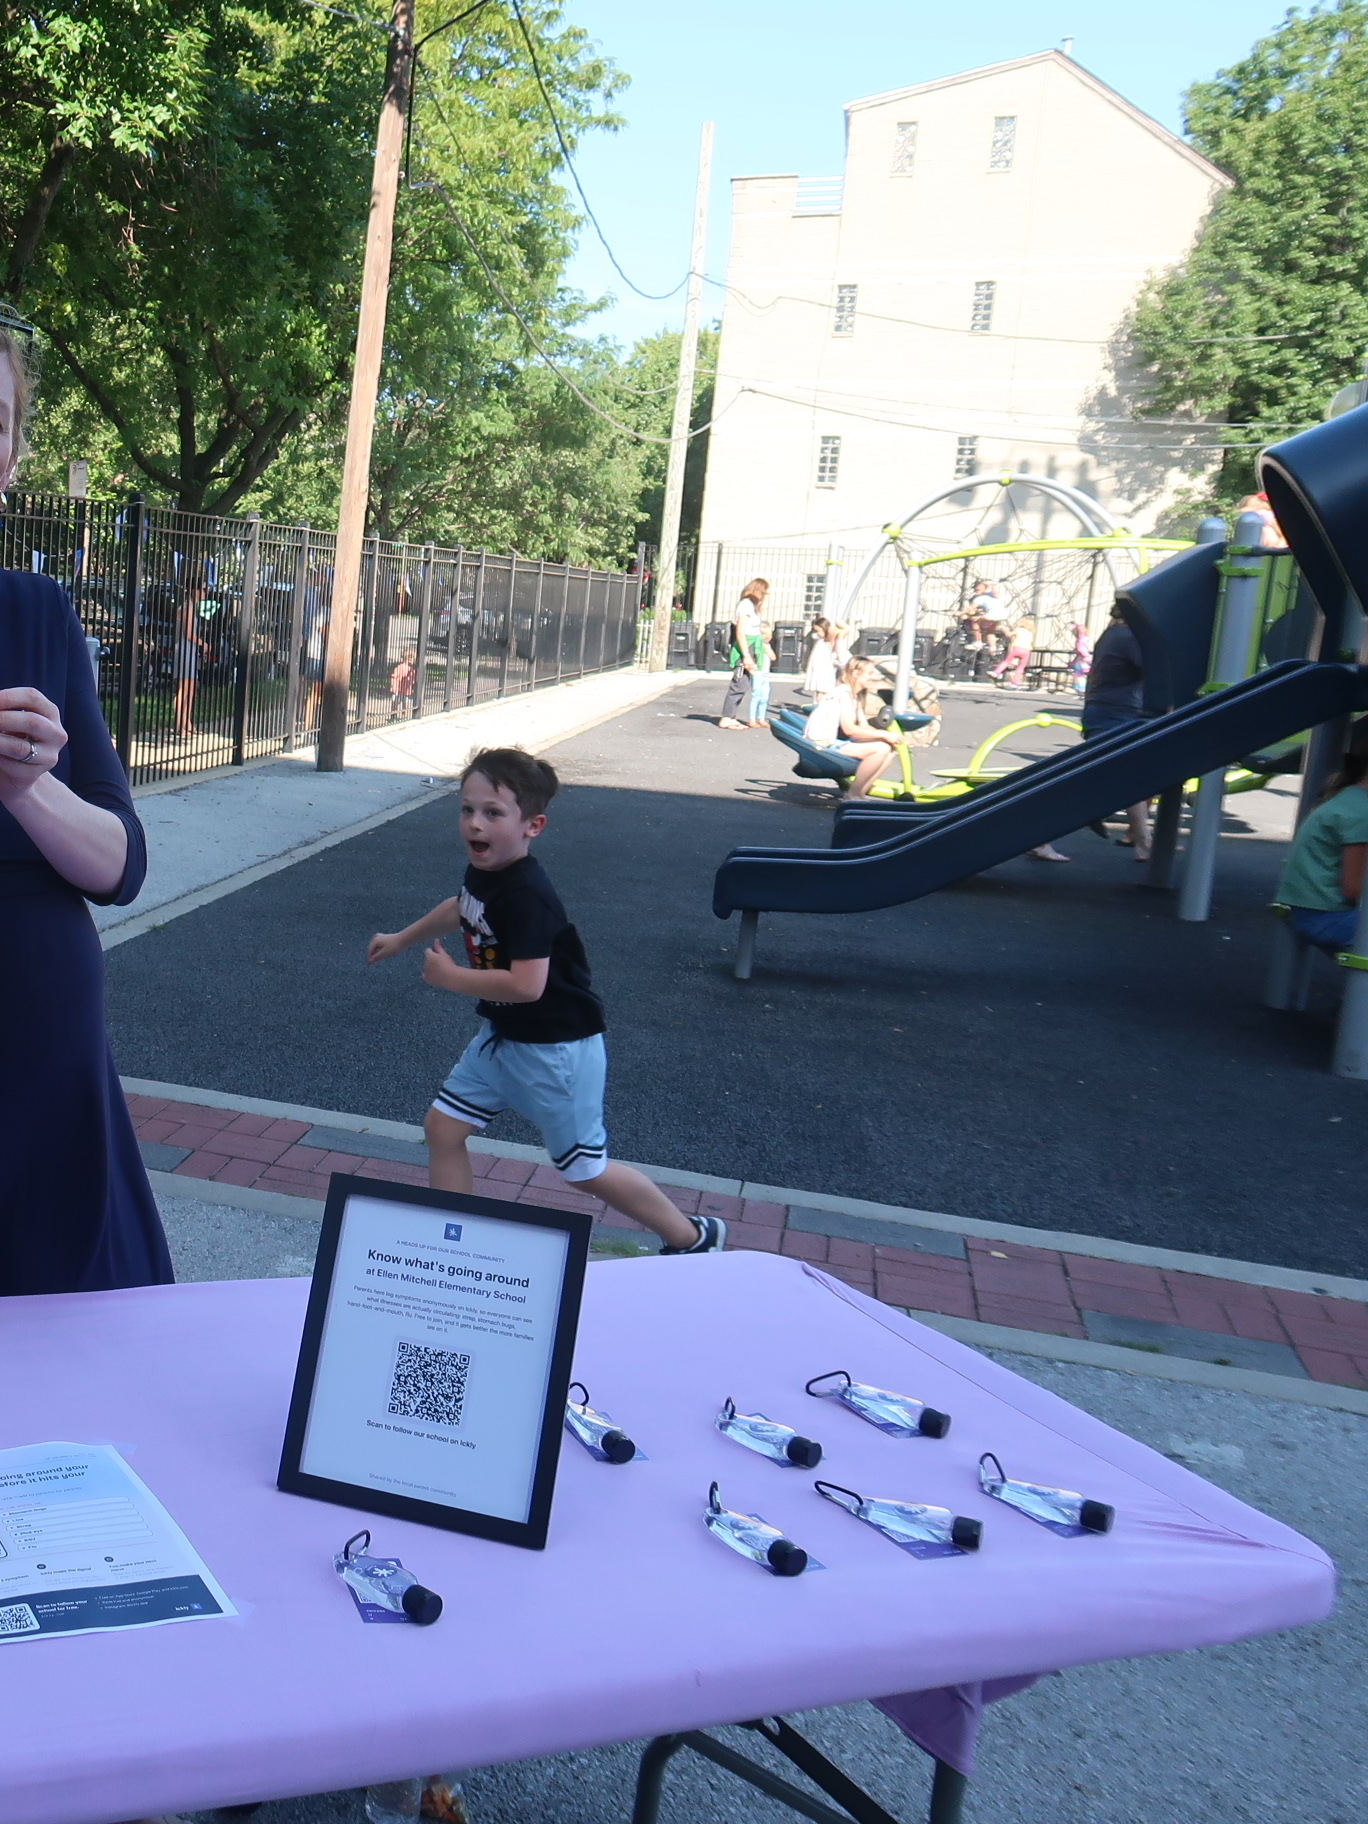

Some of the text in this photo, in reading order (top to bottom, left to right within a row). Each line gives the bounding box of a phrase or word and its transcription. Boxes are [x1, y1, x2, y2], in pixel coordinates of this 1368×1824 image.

[367, 1248, 530, 1288] Know what's going around
[365, 1267, 527, 1304] at Ellen Mitchell Elementary School
[366, 1419, 384, 1429] Scan
[384, 1423, 392, 1431] to
[392, 1425, 413, 1436] follow
[413, 1430, 426, 1438] our
[426, 1433, 450, 1443] school
[459, 1439, 477, 1450] Ickly
[25, 1467, 63, 1477] around
[65, 1464, 89, 1472] your
[39, 1474, 59, 1482] hits
[61, 1471, 86, 1480] your
